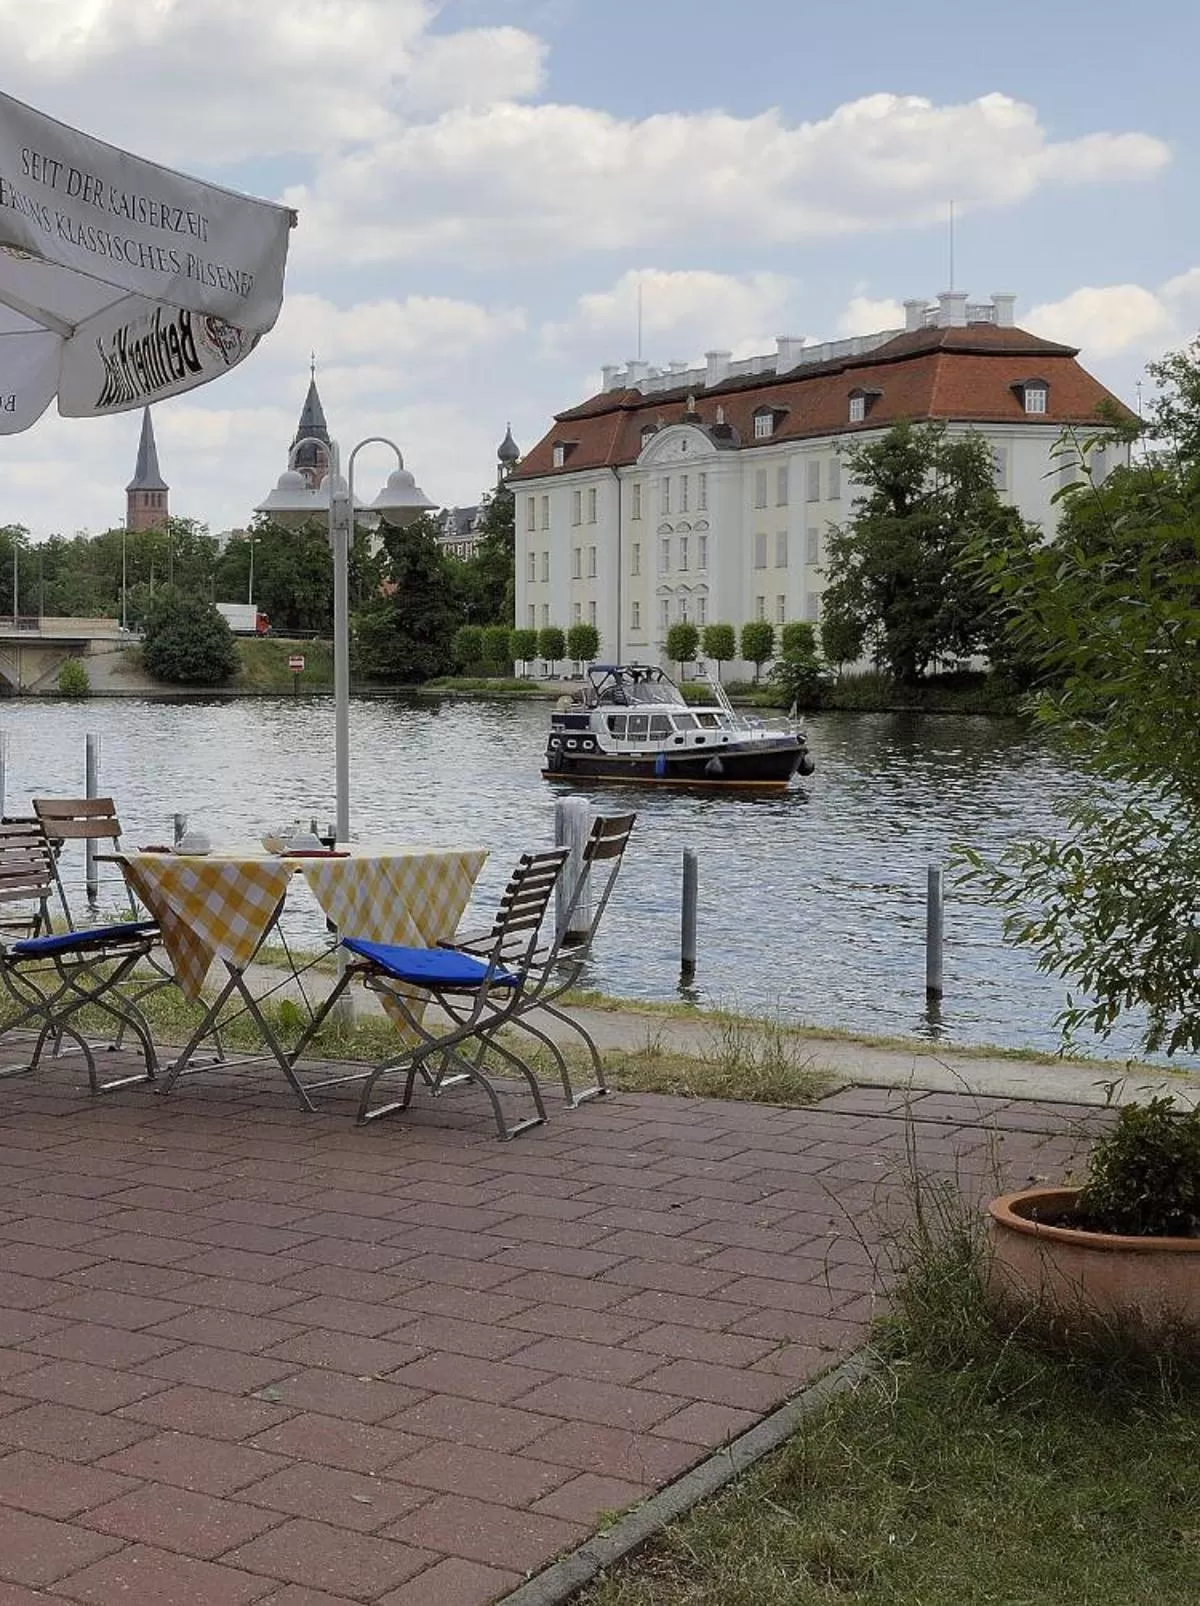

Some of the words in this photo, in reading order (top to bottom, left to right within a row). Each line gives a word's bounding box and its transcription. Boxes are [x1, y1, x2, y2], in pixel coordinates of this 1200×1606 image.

[21, 148, 63, 188] SEIT
[66, 168, 104, 208] DER
[55, 212, 181, 274] KLASSISCHES
